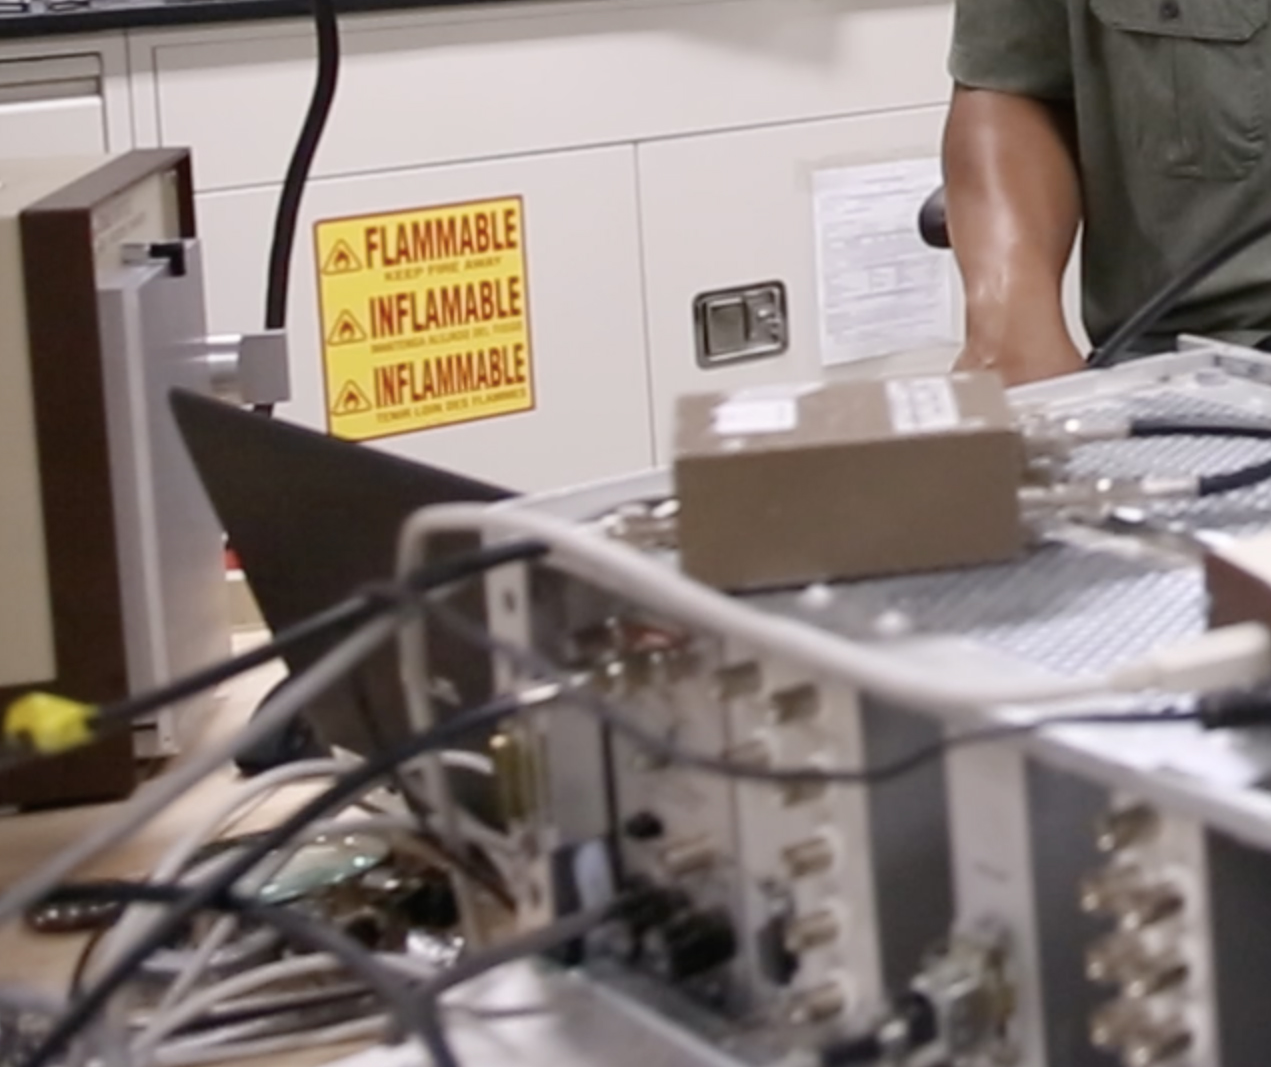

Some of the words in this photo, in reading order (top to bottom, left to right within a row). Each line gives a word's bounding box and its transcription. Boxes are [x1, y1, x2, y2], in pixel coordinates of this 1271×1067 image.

[365, 208, 518, 269] FLAMMABLE
[384, 266, 424, 281] KEEP
[428, 260, 460, 275] FIRE
[464, 256, 502, 270] AWAY
[369, 276, 522, 340] INFLAMABLE
[374, 343, 526, 409] INFLAMMABLE
